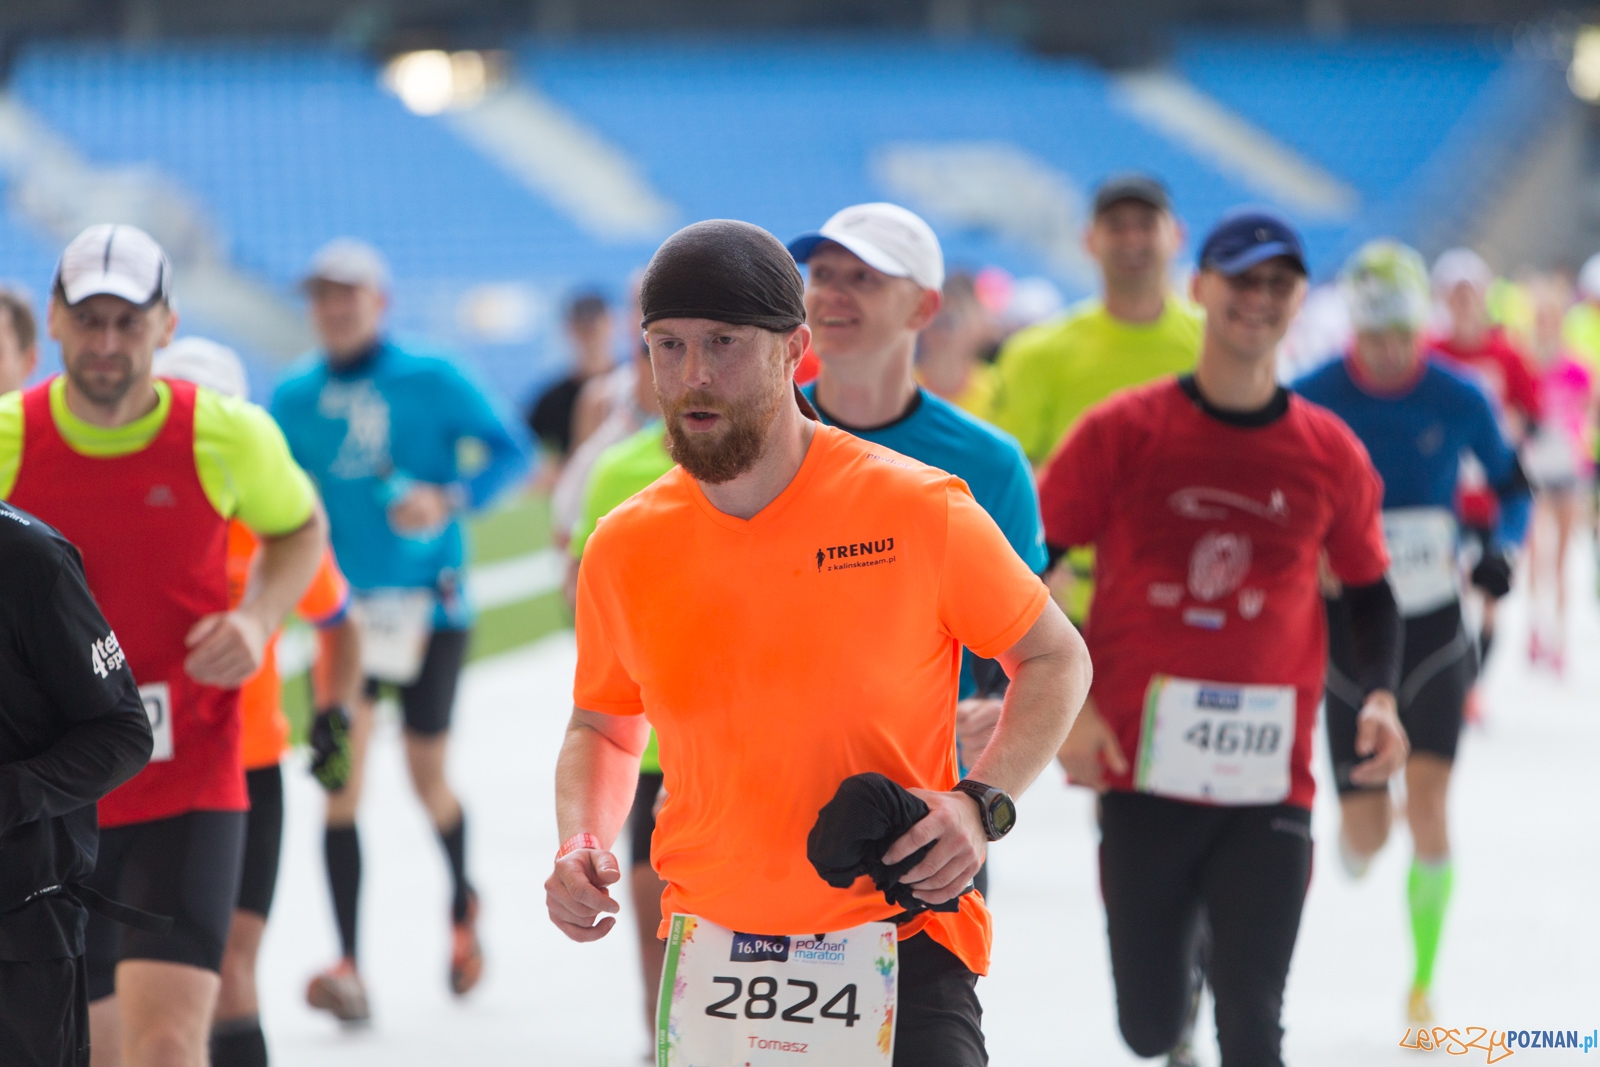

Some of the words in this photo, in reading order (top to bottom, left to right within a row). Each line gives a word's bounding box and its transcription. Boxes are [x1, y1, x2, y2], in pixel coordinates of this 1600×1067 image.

[826, 537, 895, 560] TRENUJ
[833, 555, 897, 571] kalinskateam.pl
[736, 940, 785, 954] 16.PKO
[794, 949, 845, 961] maraton
[705, 976, 860, 1027] 2824
[748, 1036, 808, 1053] Tomasz
